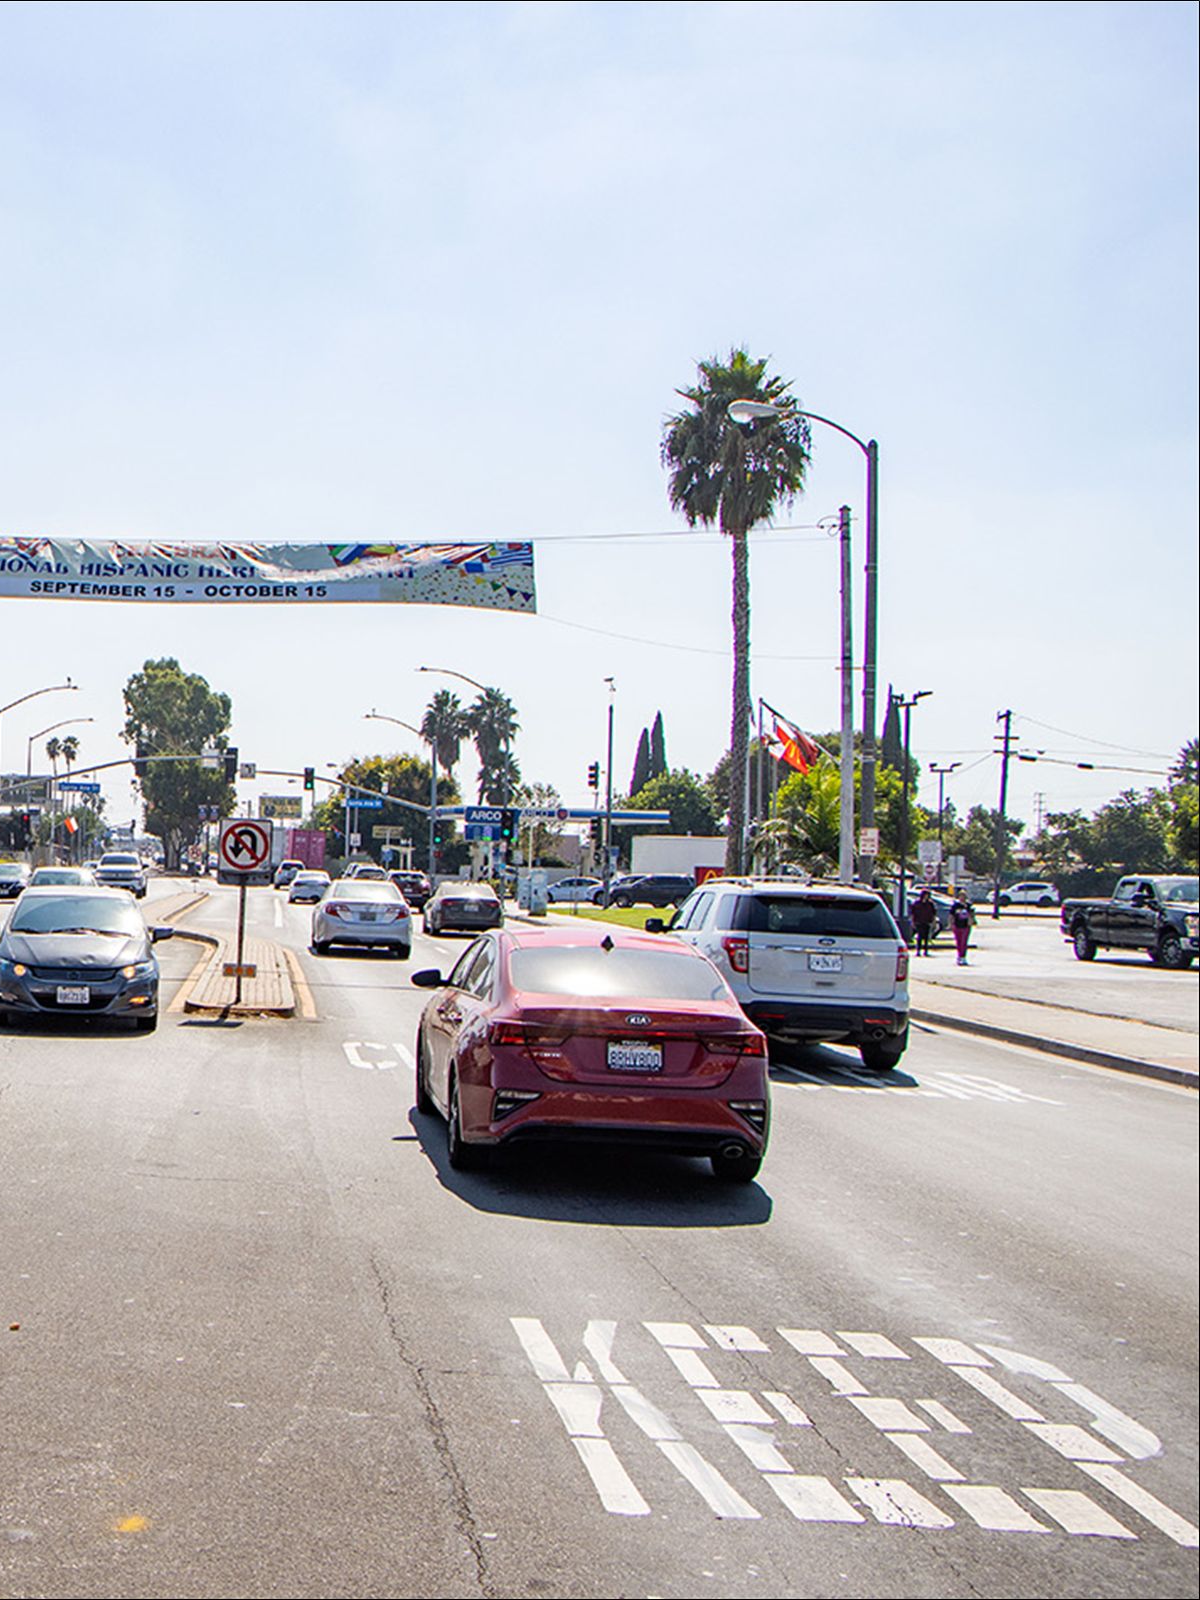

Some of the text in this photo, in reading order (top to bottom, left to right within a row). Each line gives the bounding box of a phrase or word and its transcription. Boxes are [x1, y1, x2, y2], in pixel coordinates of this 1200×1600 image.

[80, 562, 189, 578] HISPANIC
[30, 580, 146, 597] SEPTEMBER
[153, 586, 175, 597] 15
[204, 585, 298, 597] OCTOBER
[305, 585, 327, 597] 15
[470, 811, 502, 820] ARCO
[631, 1016, 646, 1024] KIA
[508, 1317, 1198, 1548] KEEP
